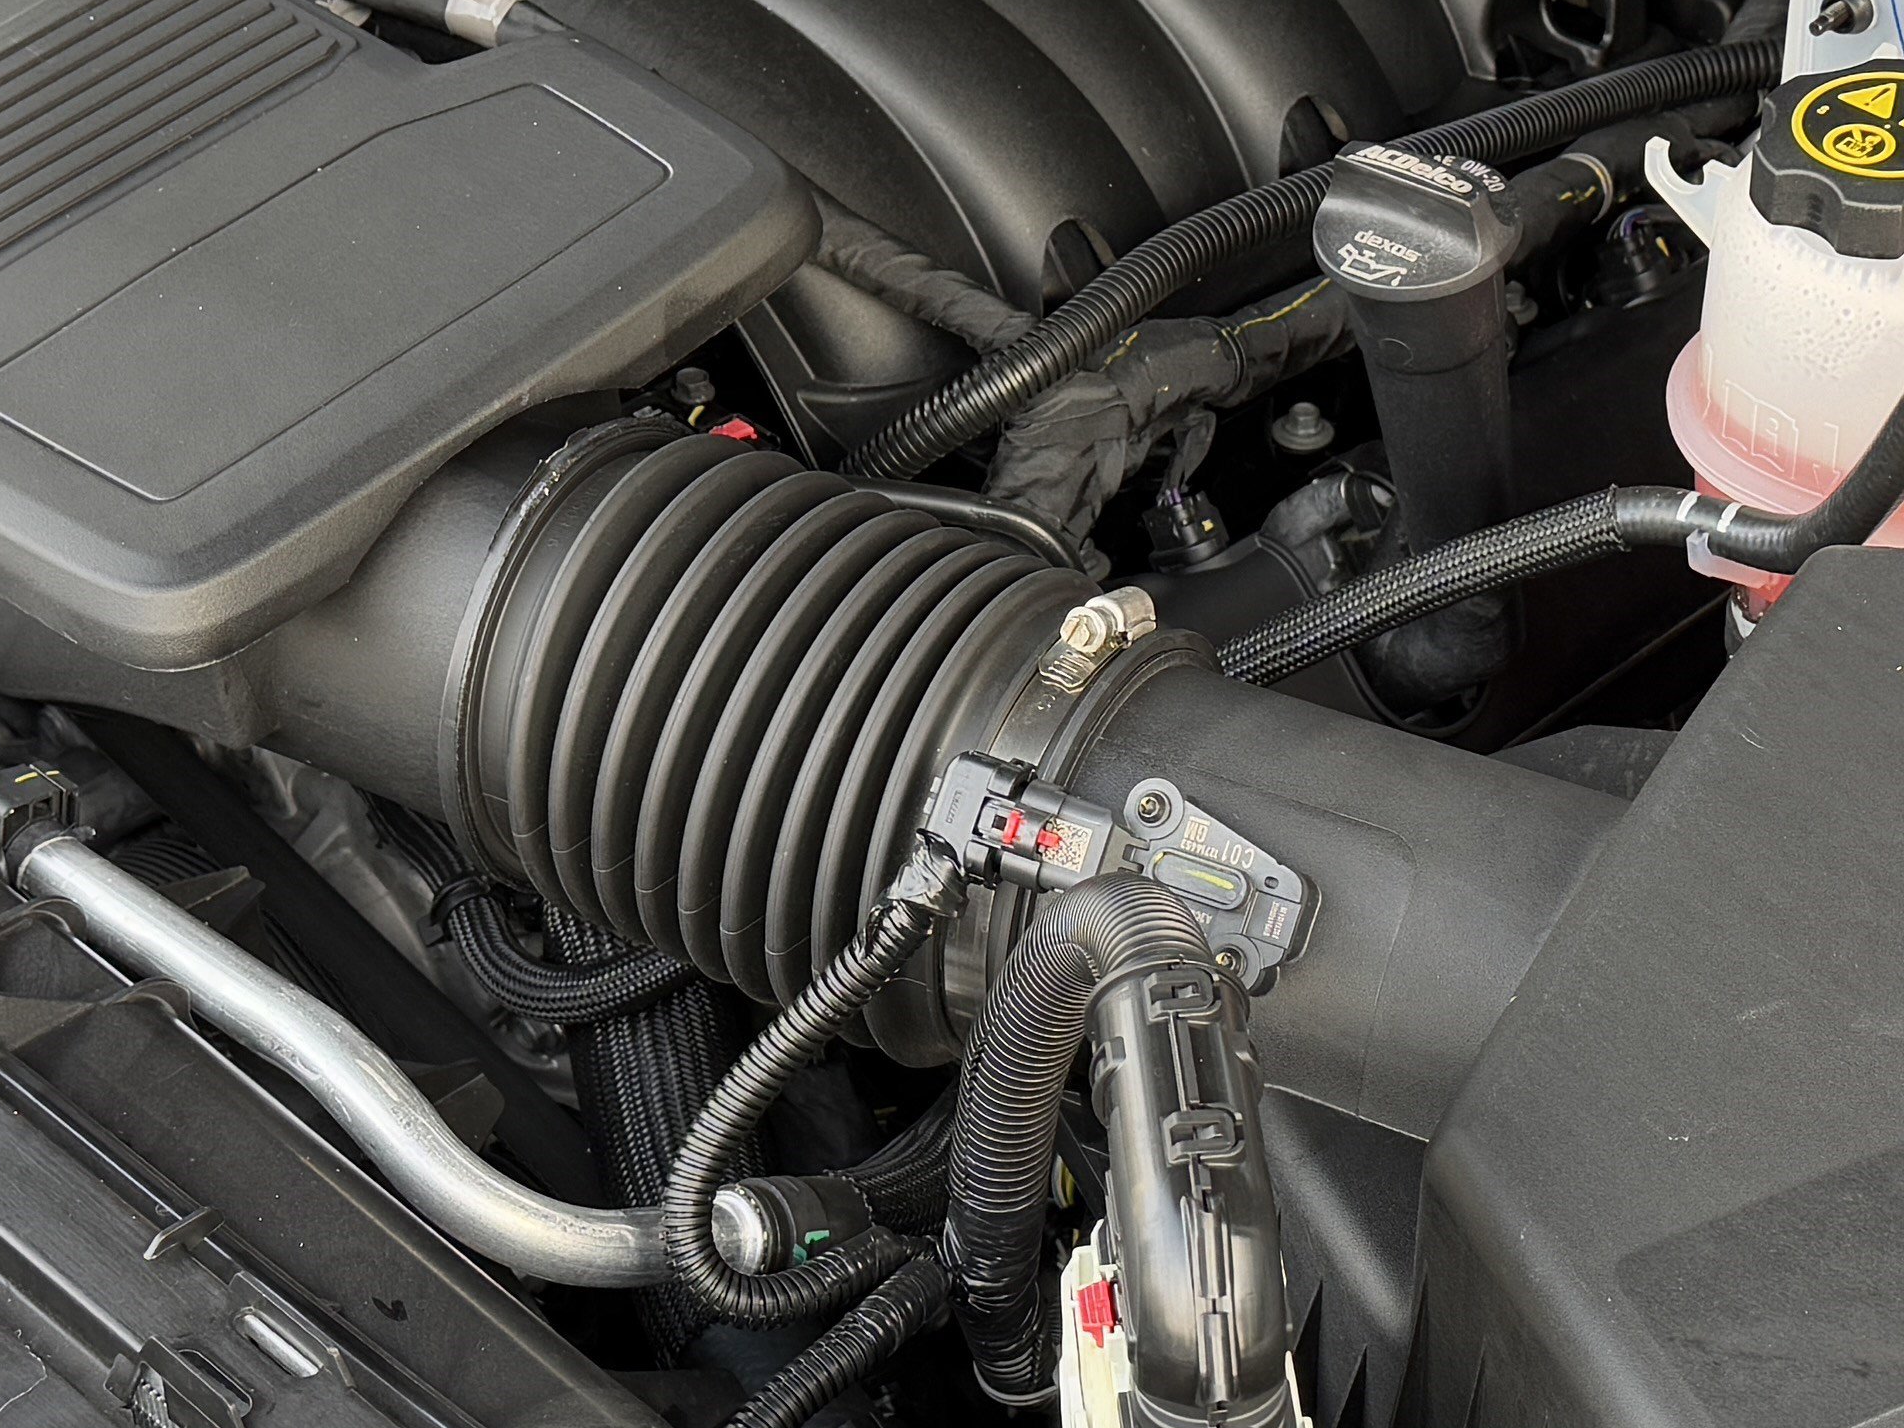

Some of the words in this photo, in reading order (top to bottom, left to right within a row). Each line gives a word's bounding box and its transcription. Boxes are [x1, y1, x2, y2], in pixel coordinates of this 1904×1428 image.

[1355, 144, 1473, 195] ACDelco
[1461, 159, 1506, 194] 0W-20
[1353, 229, 1421, 263] dexos
